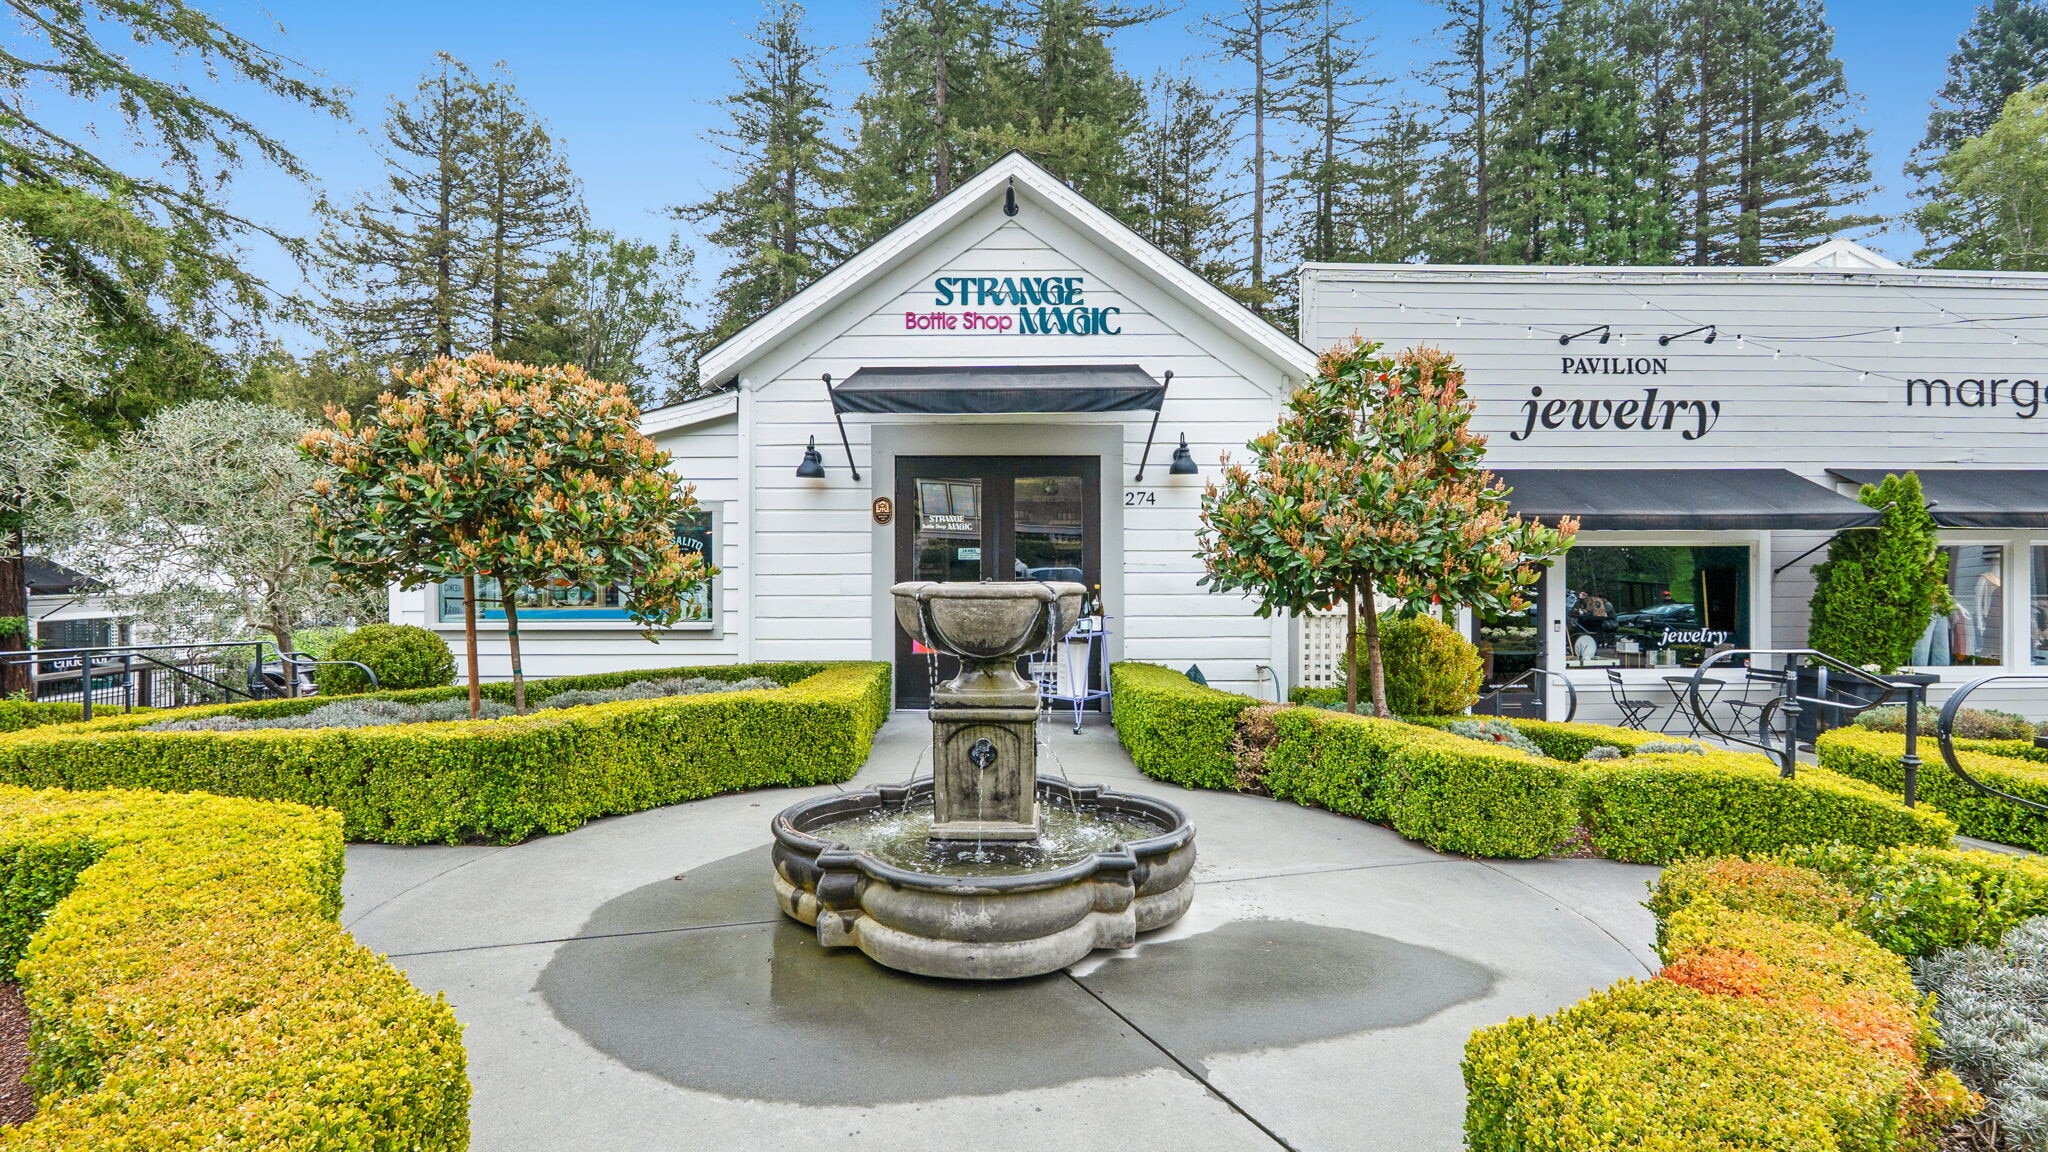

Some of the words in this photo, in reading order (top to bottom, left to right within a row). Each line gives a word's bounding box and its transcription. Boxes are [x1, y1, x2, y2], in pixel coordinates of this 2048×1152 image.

[934, 276, 1084, 306] STRANGE
[905, 312, 957, 330] Bottle
[962, 312, 1013, 333] Shop
[1019, 306, 1121, 336] MAGIC
[1561, 357, 1668, 375] PAVILION
[1906, 378, 2048, 419] marg
[1509, 385, 1721, 441] jewelry
[1125, 491, 1156, 506] 274
[669, 535, 704, 551] SALITO
[1657, 627, 1729, 647] jewelry
